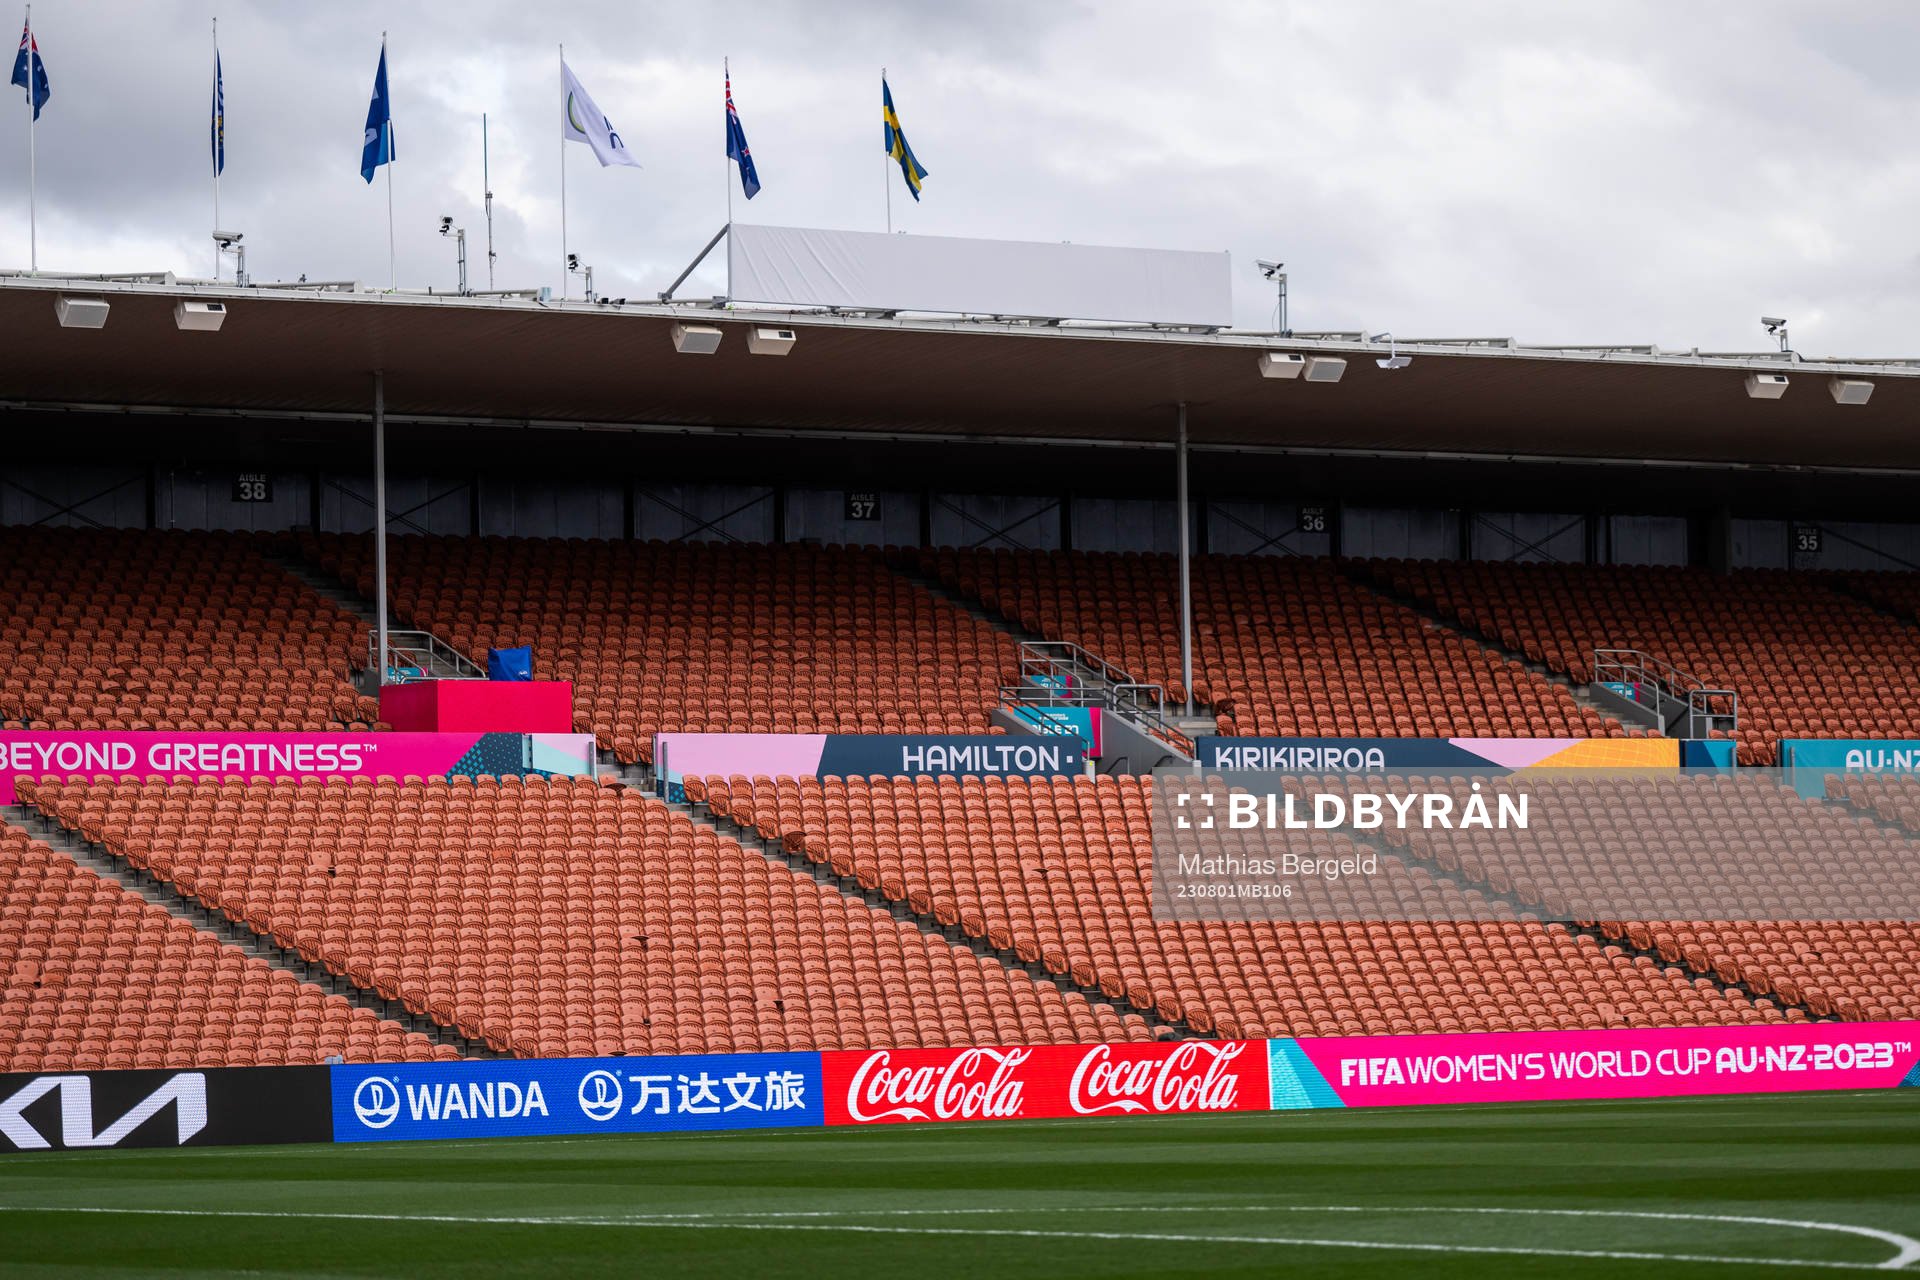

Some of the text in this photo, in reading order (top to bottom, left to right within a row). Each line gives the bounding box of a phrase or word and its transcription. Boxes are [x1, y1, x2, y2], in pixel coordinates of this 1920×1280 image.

[239, 482, 266, 500] 38
[851, 501, 875, 518] 37
[1303, 515, 1324, 531] 36
[1798, 535, 1818, 550] 35
[902, 745, 1060, 772] HAMILTON
[1214, 746, 1385, 773] KIRIKIRIROA
[1068, 1041, 1248, 1114] Coca-Cola
[1340, 1057, 1406, 1087] FIFA
[1405, 1053, 1546, 1085] WOMEN'S
[1548, 1050, 1652, 1080] WORLD
[1655, 1048, 1712, 1077] CUP
[628, 1070, 806, 1116] 万达文旅
[846, 1048, 1033, 1122] Coca-Cola
[405, 1081, 550, 1121] WANDA
